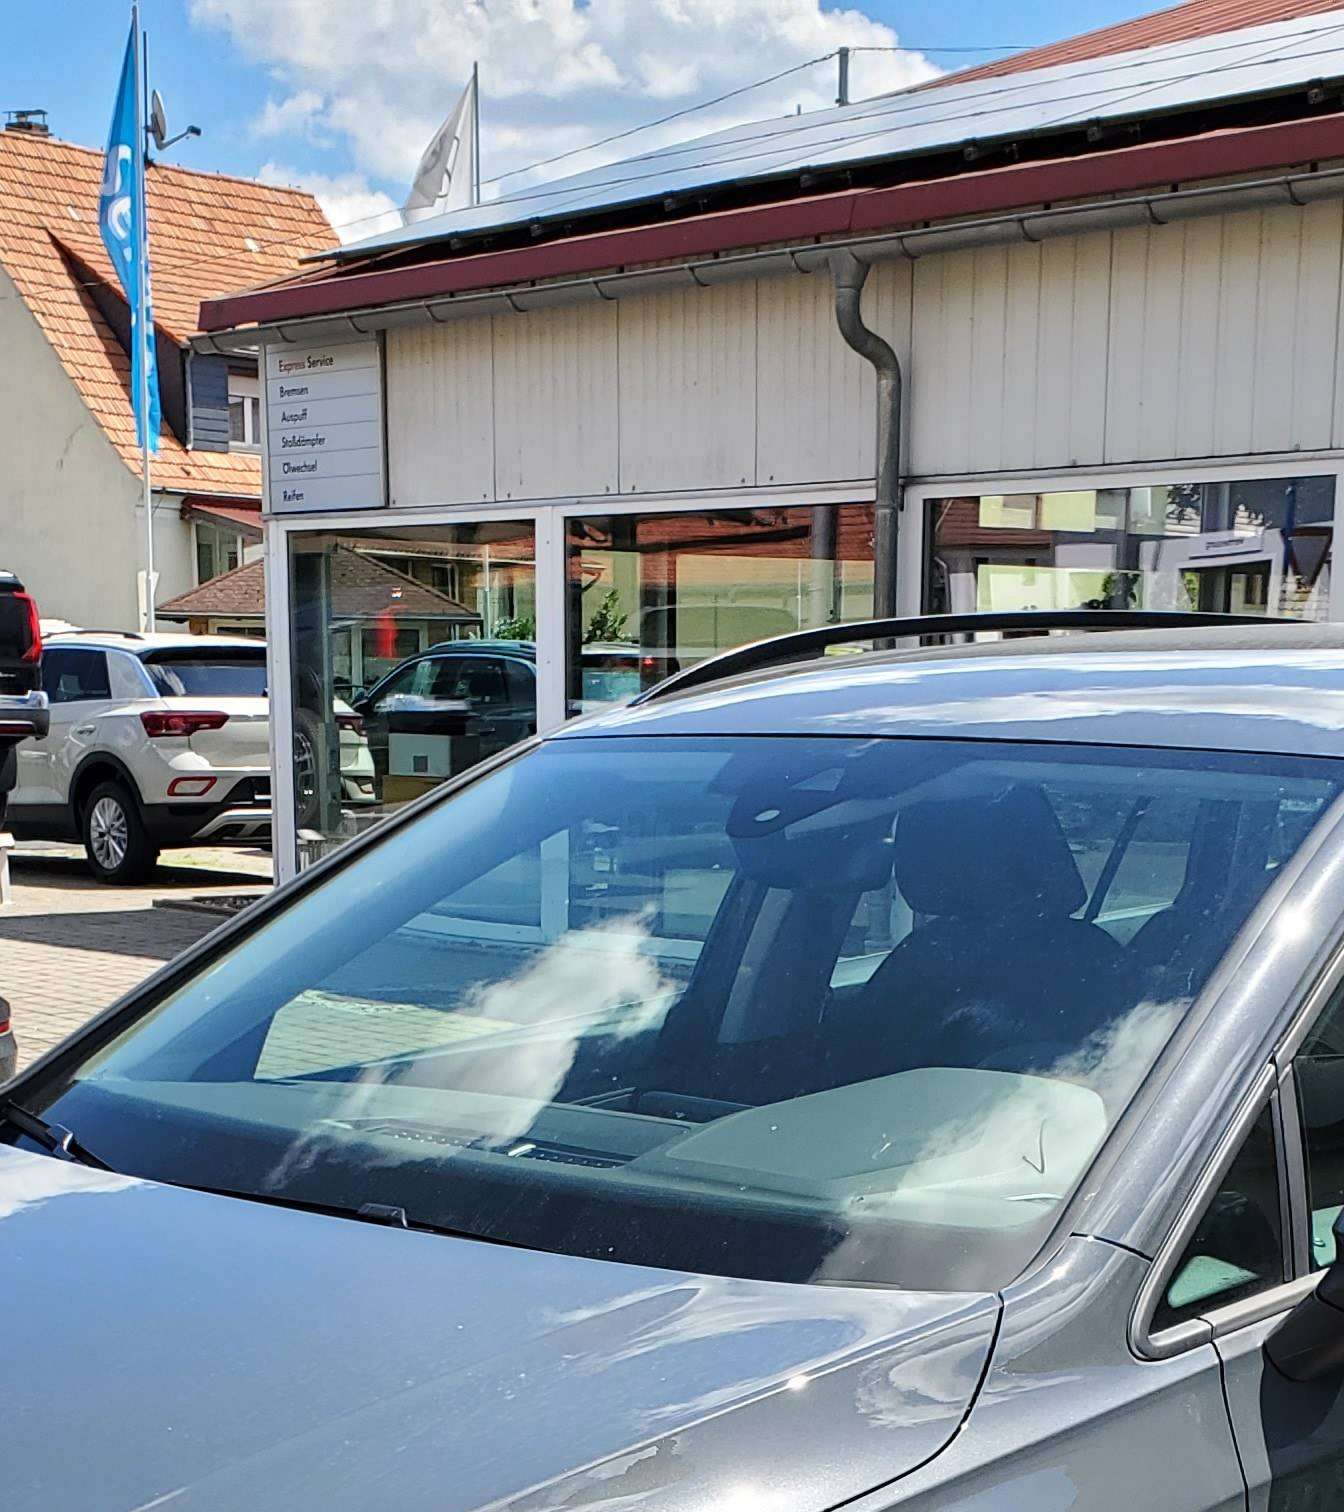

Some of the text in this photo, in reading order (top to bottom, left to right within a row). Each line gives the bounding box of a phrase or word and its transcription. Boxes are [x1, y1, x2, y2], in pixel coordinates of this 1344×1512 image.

[307, 354, 335, 368] Service
[280, 385, 309, 398] Bremsen
[281, 408, 308, 424] Auspuff
[282, 489, 305, 502] Reifen
